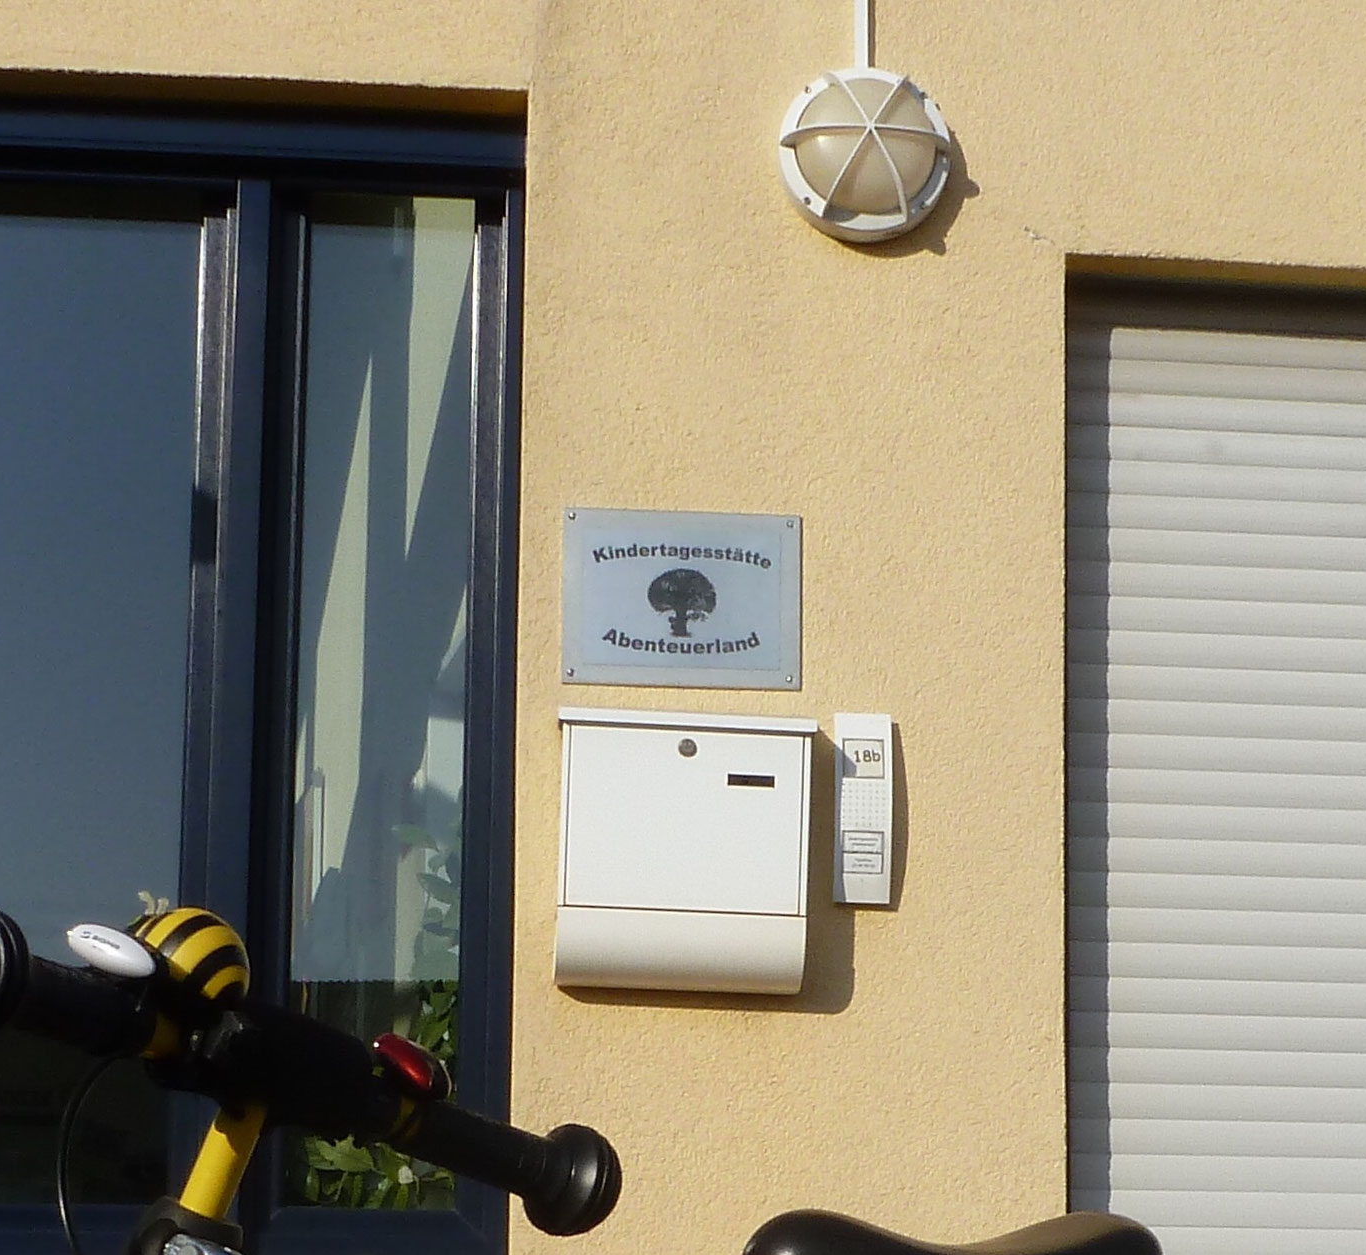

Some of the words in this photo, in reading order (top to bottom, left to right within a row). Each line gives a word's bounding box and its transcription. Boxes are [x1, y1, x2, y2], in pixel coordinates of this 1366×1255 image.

[592, 543, 772, 569] Kindertagesstätte
[602, 628, 760, 654] Abenteuerland
[854, 748, 881, 763] 18b
